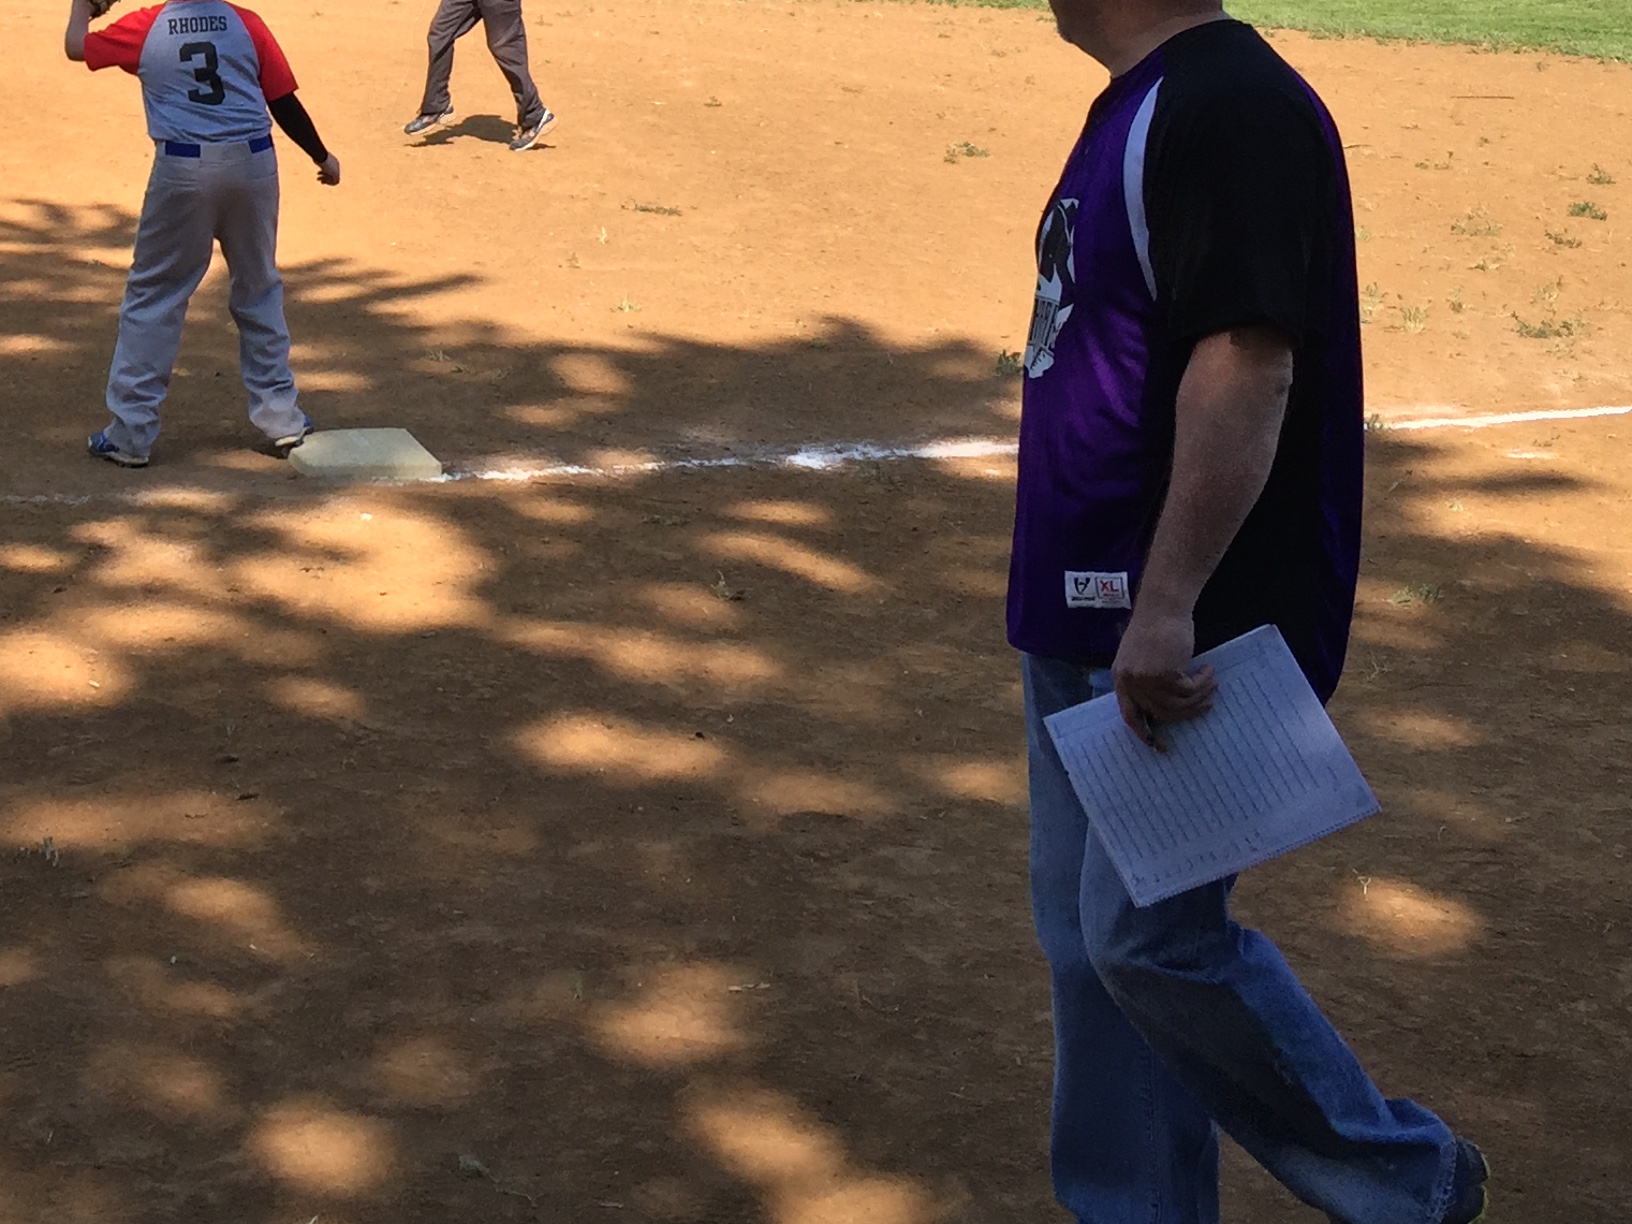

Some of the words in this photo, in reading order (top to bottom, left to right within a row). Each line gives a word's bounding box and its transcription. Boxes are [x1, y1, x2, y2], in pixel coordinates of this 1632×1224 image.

[167, 15, 228, 35] RHODES
[179, 41, 225, 106] 3
[1100, 580, 1119, 592] XL
